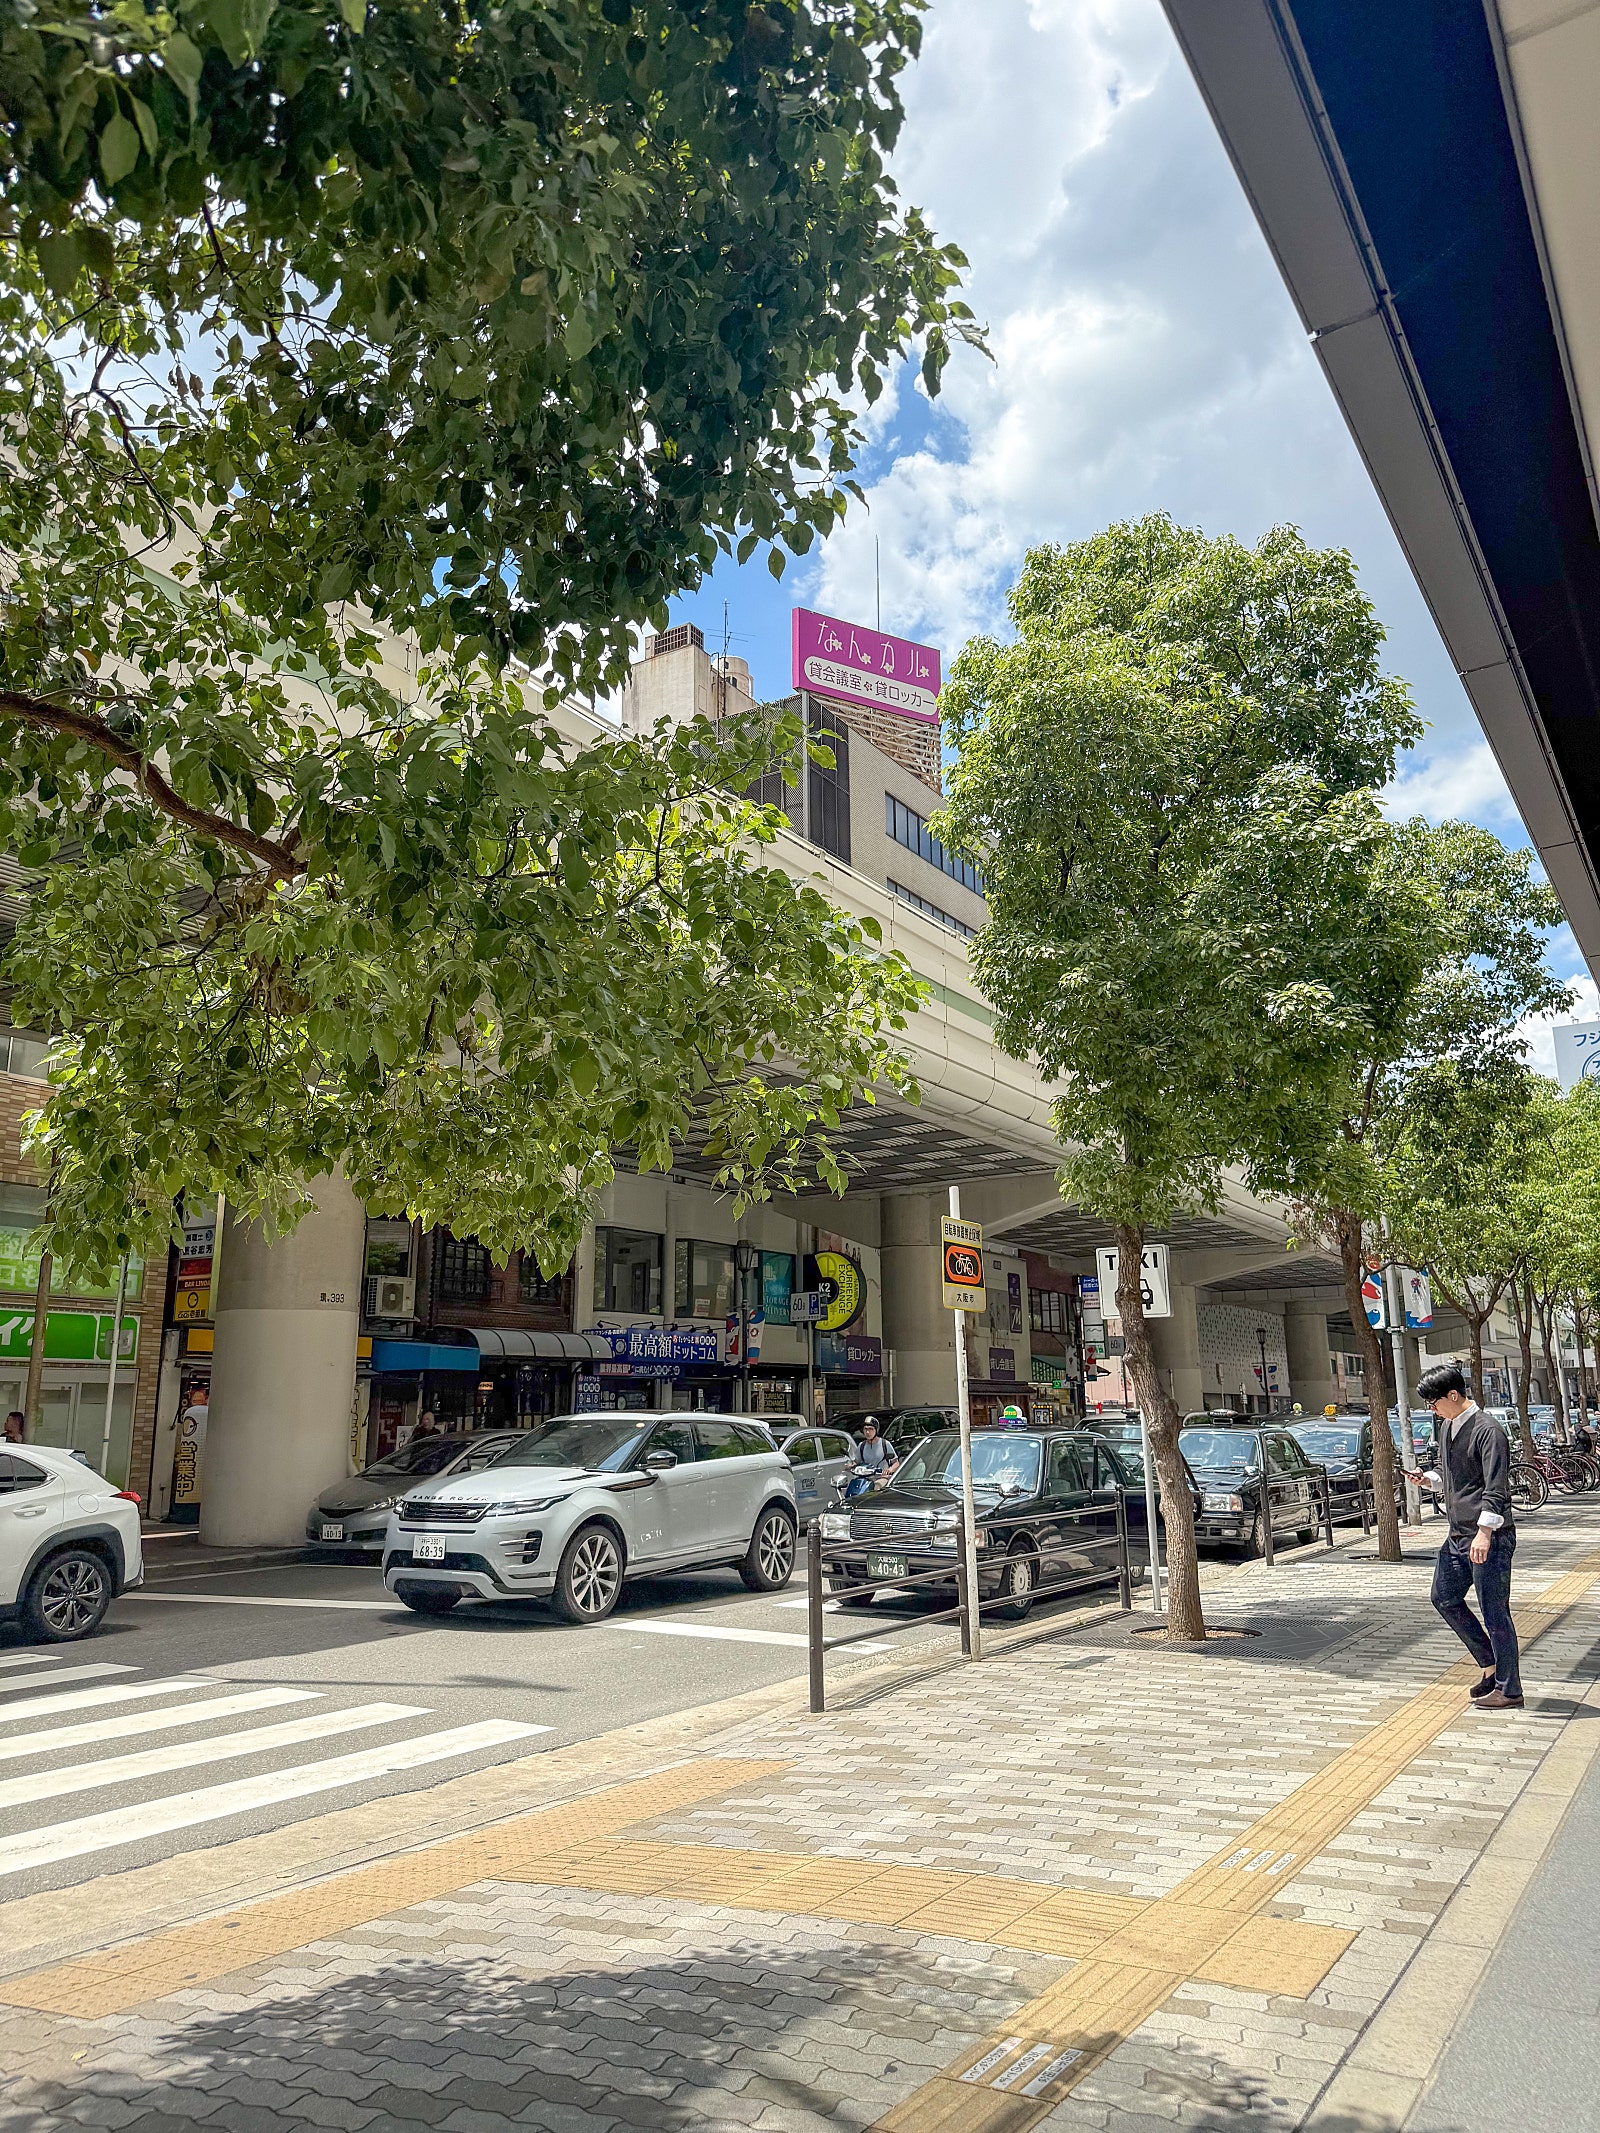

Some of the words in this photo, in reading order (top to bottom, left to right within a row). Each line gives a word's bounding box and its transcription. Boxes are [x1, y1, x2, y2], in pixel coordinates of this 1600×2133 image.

[817, 621, 930, 678] なんカル
[809, 661, 862, 691] 貸会議室
[875, 680, 935, 708] 貸ロッカー
[944, 1223, 981, 1242] 自転車放置禁止区域
[1105, 1252, 1159, 1271] TXI
[838, 1264, 846, 1314] EXCHANGE
[845, 1264, 854, 1314] CURRENCY
[956, 1293, 975, 1303] 大阪市
[629, 1332, 672, 1358] 最高額
[673, 1345, 715, 1360] ドットコム
[847, 1346, 880, 1362] 貸ロッカー
[420, 1546, 444, 1558] 68-39
[877, 1563, 905, 1576] 40-43
